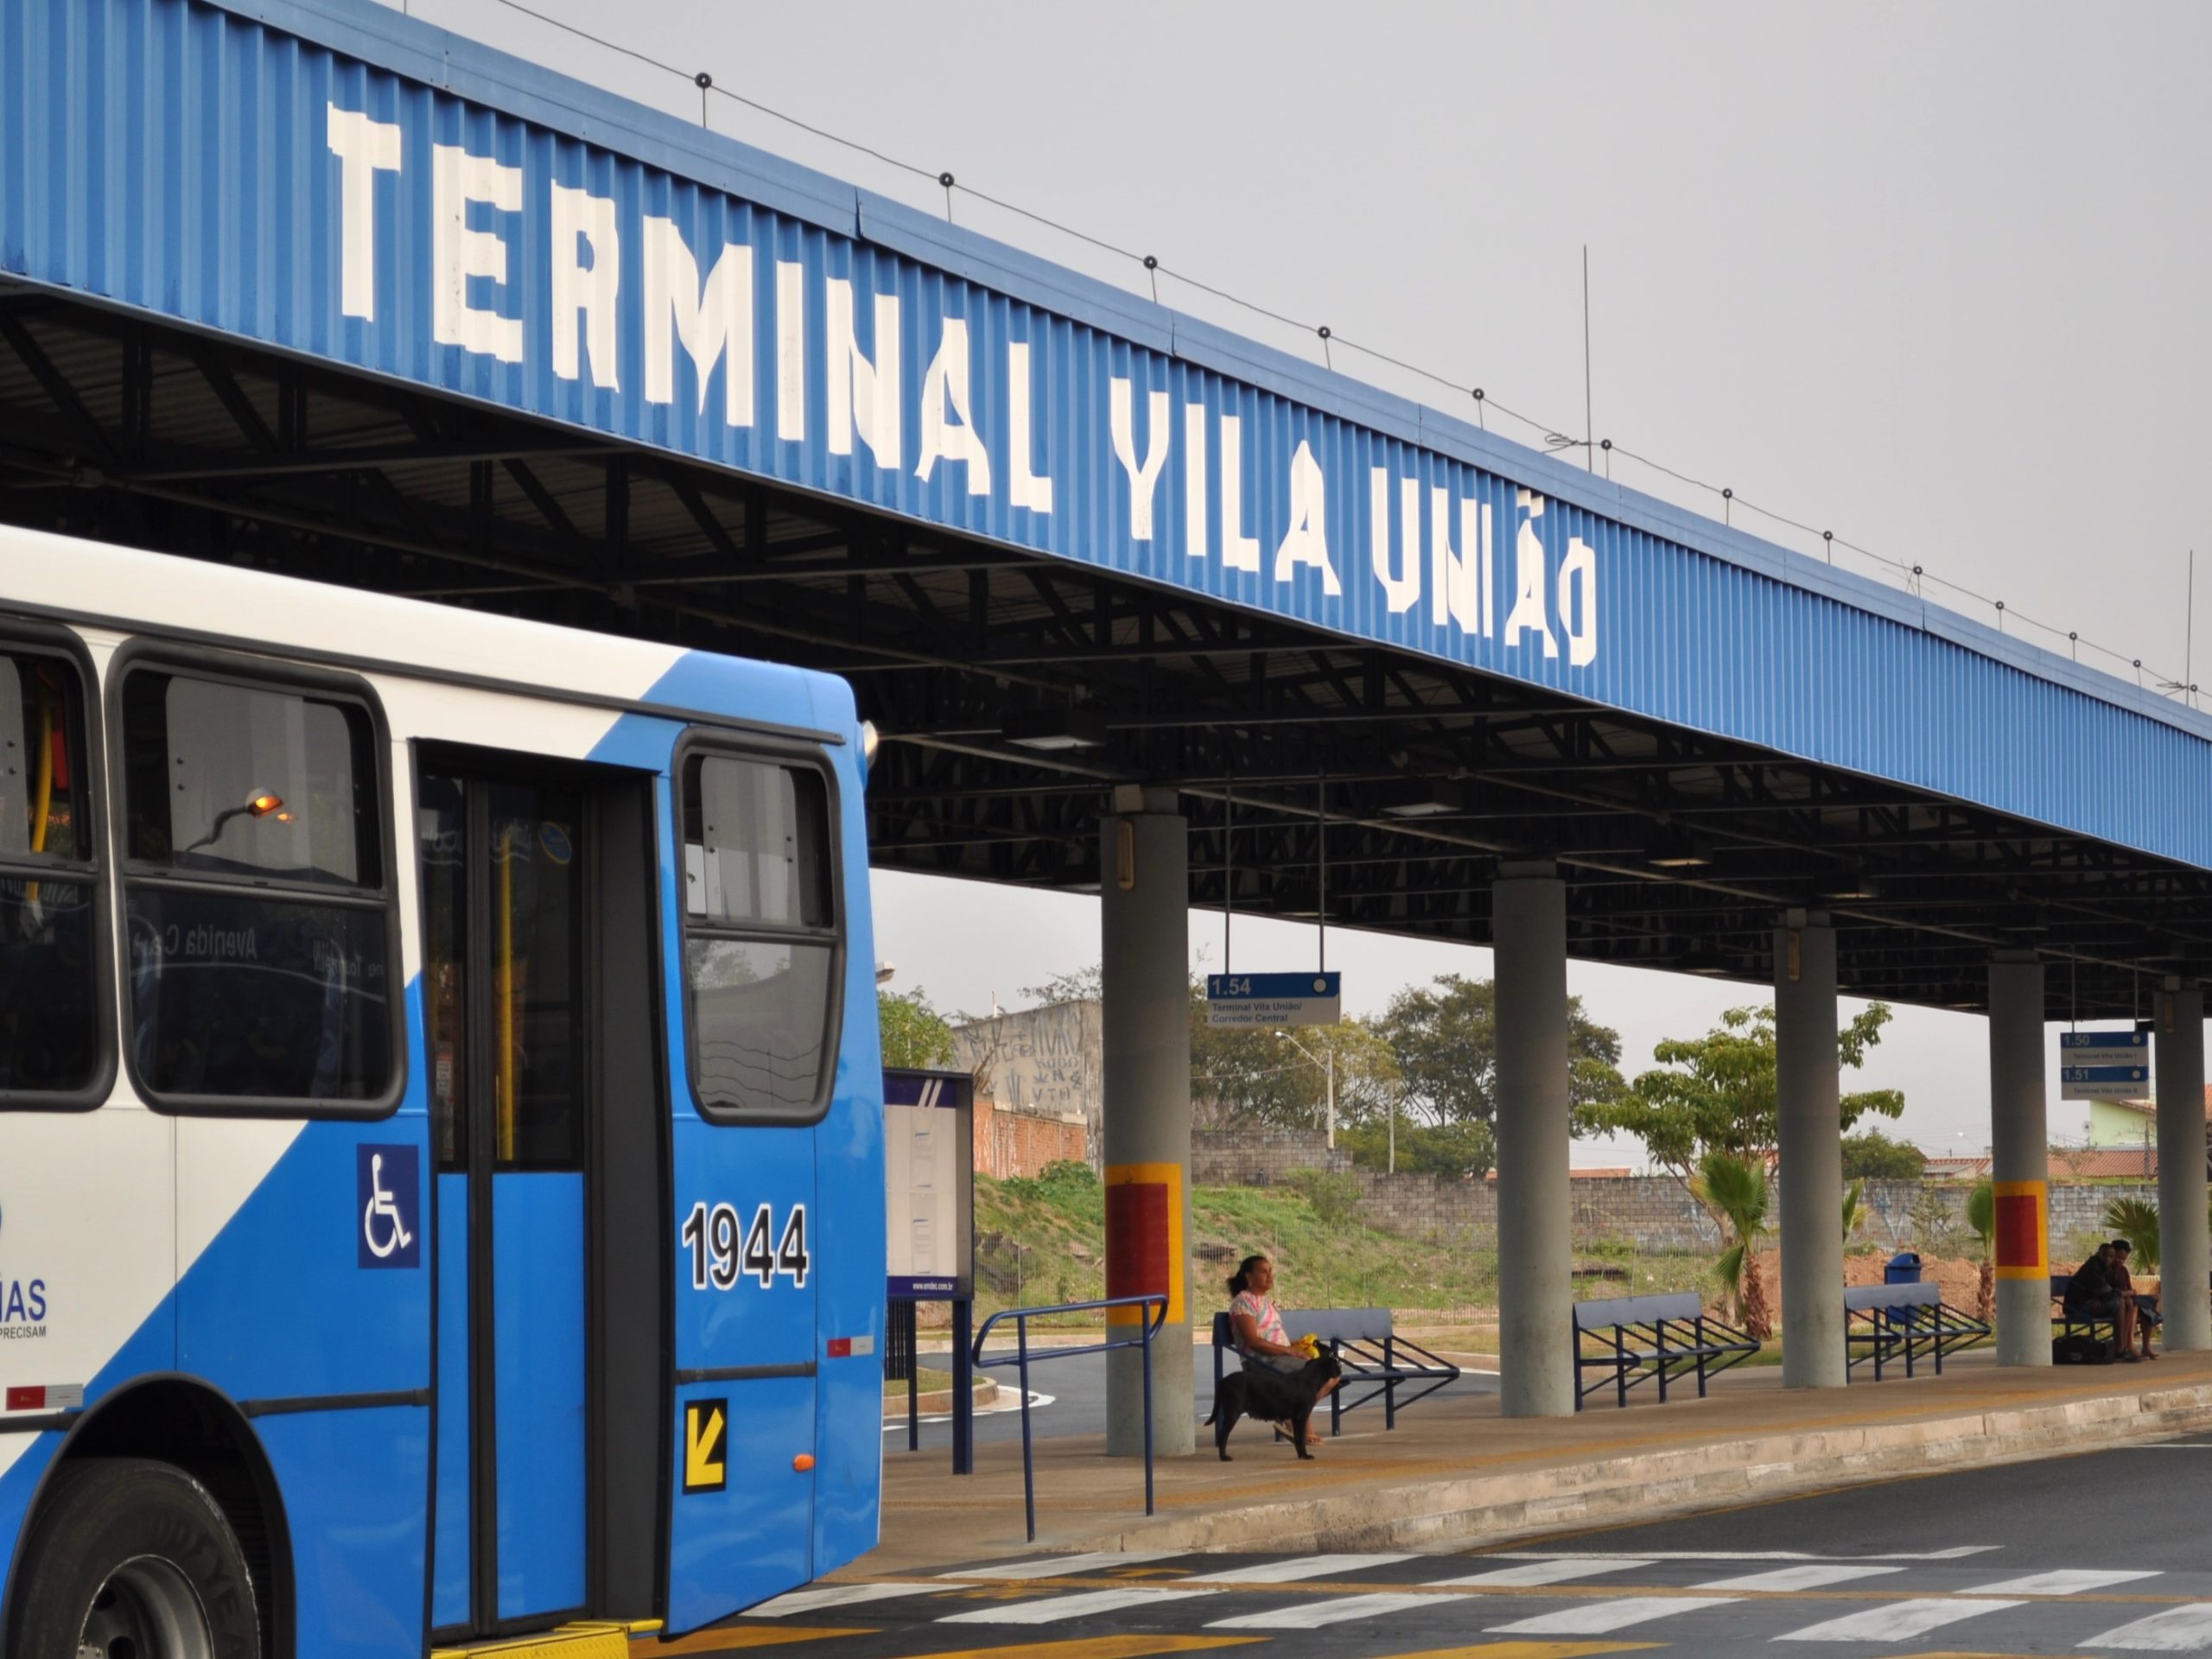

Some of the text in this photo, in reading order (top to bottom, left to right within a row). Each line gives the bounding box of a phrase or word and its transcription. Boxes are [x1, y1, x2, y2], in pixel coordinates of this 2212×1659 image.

[327, 101, 1052, 515] TERMINAL
[1371, 489, 1597, 667] UNIÃO
[1211, 977, 1251, 995] 1.54
[1212, 1003, 1251, 1012] Terminal
[1254, 1002, 1270, 1012] Vila
[1212, 1014, 1287, 1023] Corredor Central
[2064, 1034, 2090, 1046] 1.50
[2064, 1069, 2089, 1080] 1.51
[682, 1202, 809, 1290] 1944
